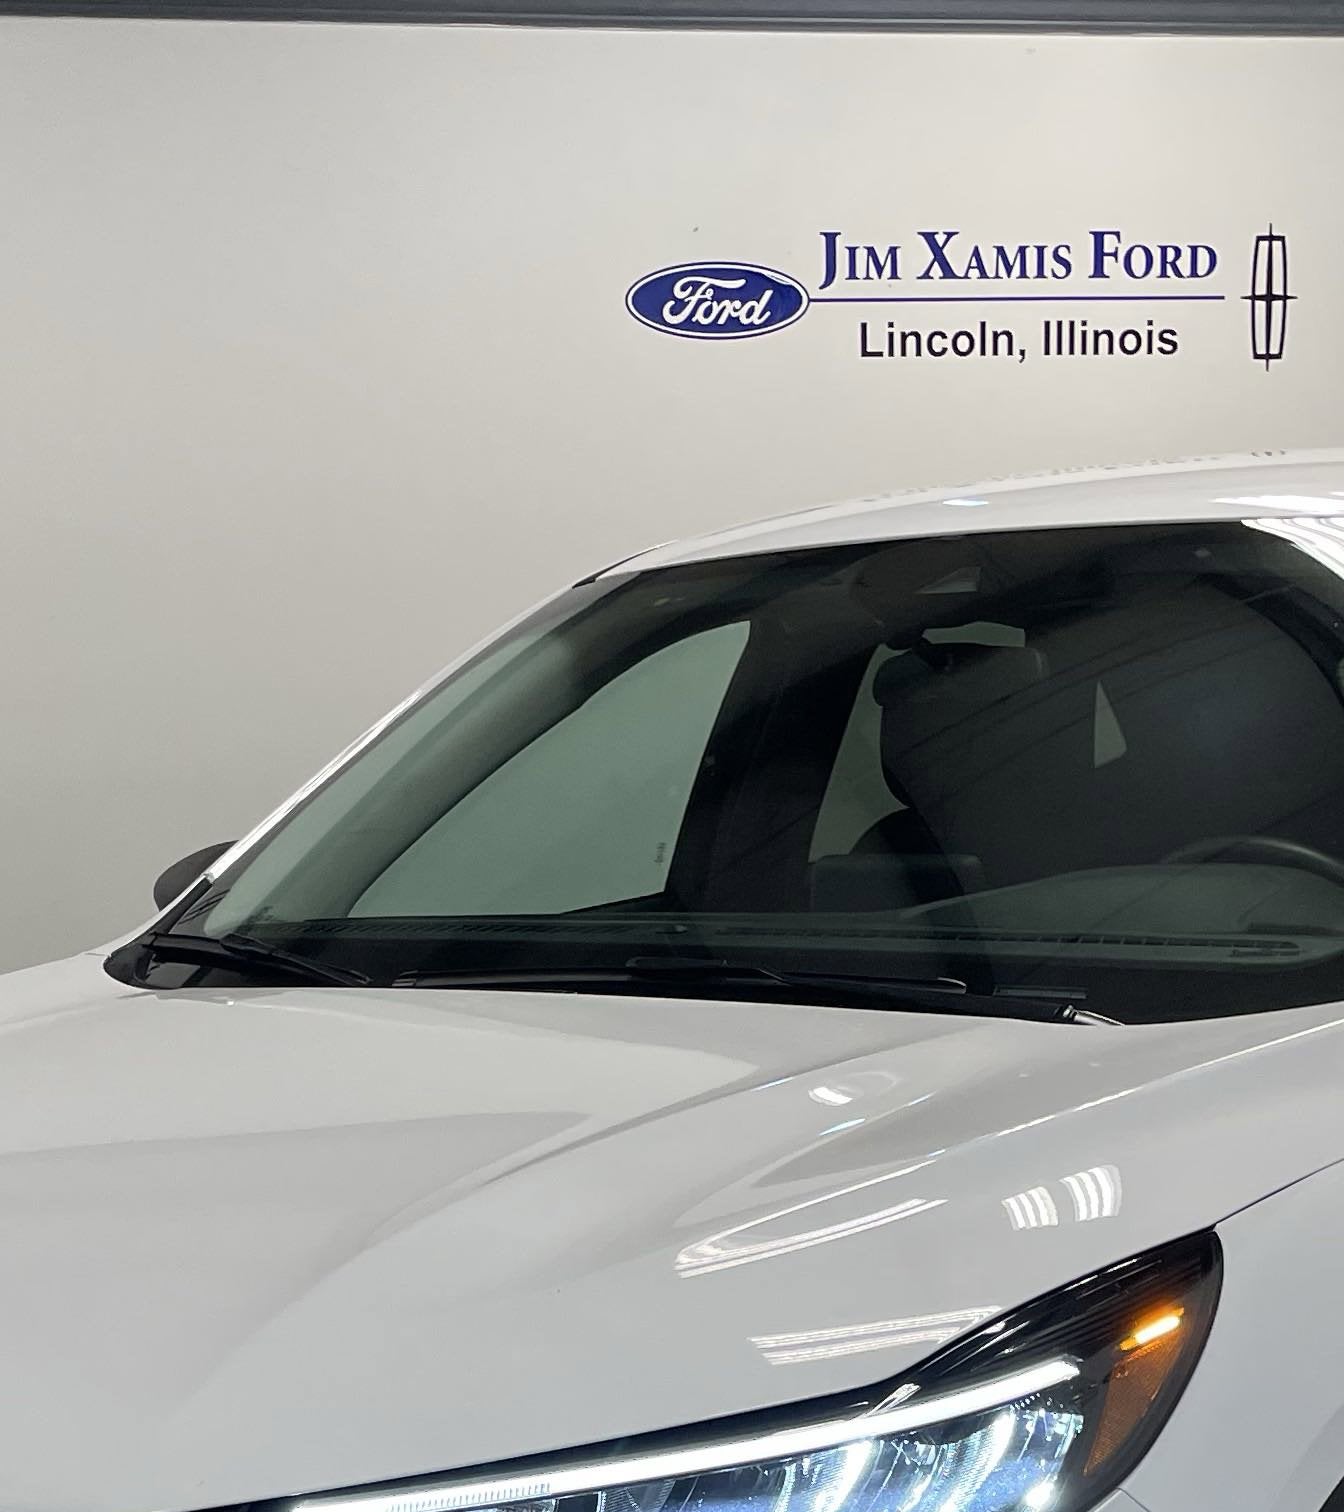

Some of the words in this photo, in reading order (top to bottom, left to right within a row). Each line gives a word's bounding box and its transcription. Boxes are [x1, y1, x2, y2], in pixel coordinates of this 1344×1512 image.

[818, 231, 901, 290] JIM
[916, 231, 1073, 280] XAMIS
[1088, 230, 1218, 280] FORD
[661, 274, 775, 328] Ford
[860, 321, 1026, 364] Lincoln,
[1044, 320, 1179, 356] Illinois
